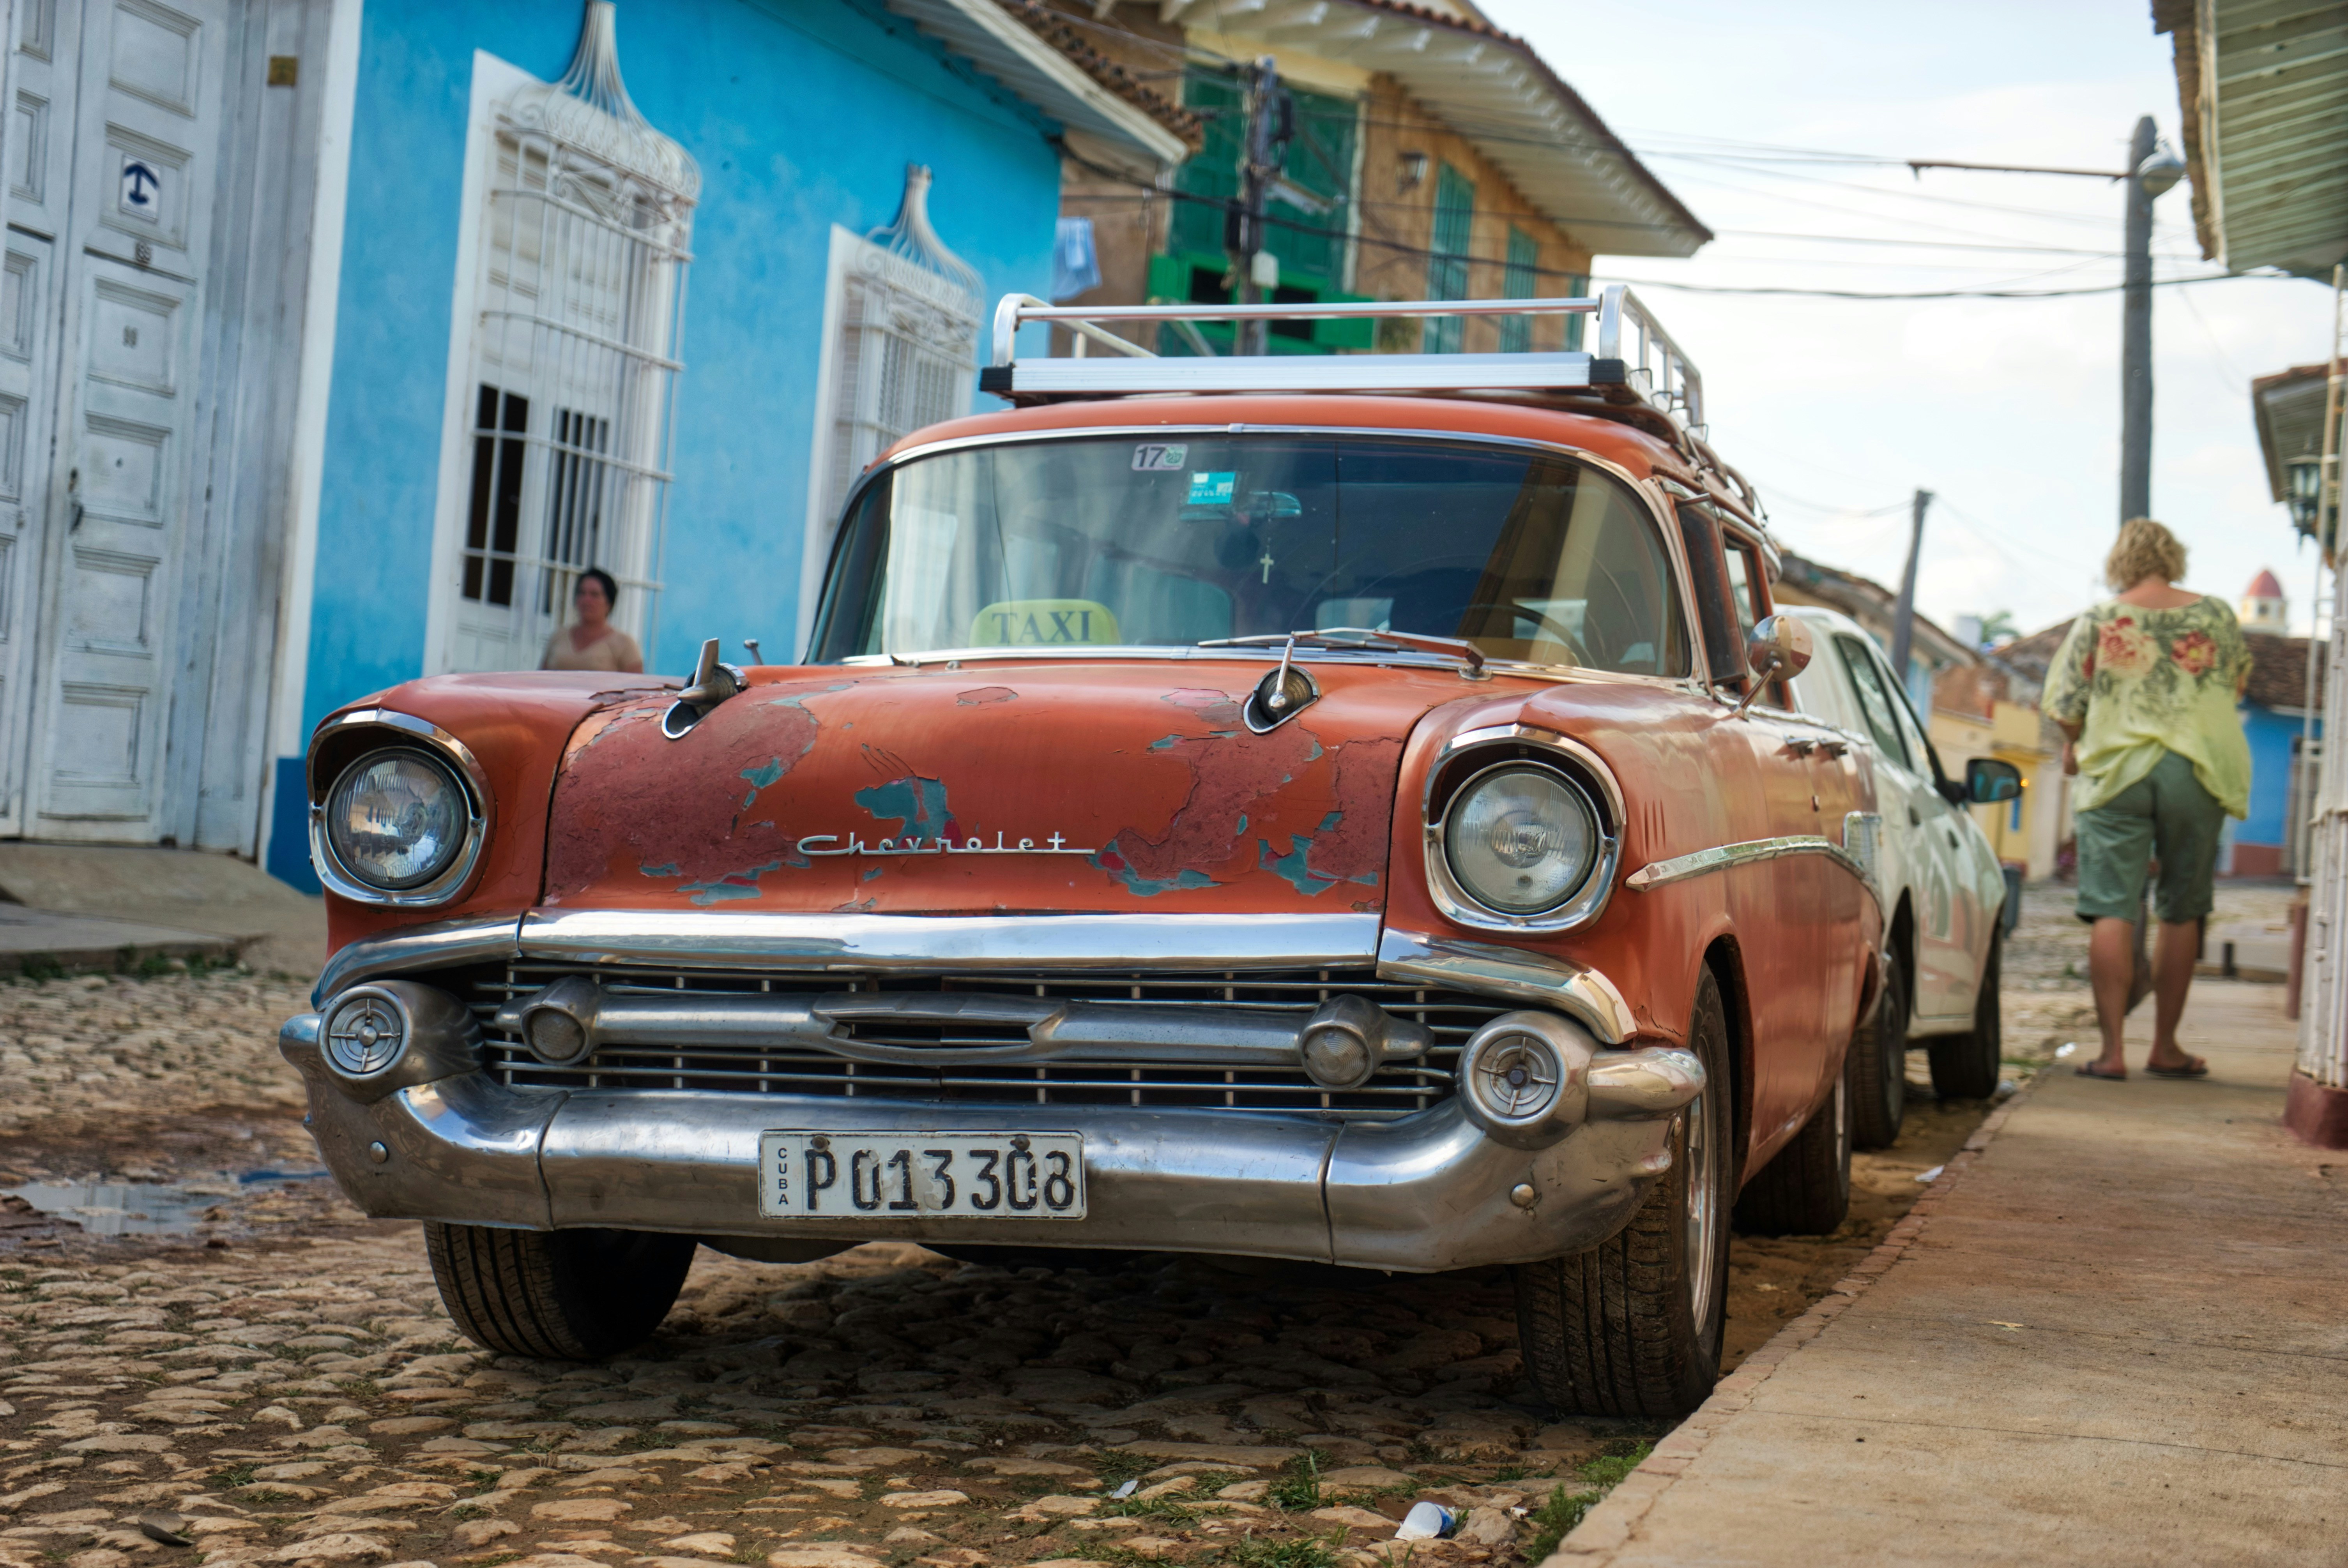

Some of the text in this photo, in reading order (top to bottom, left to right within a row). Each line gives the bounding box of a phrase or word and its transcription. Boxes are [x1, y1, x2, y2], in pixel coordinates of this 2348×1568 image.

[1137, 446, 1166, 467] 17
[992, 611, 1093, 644] TAXI
[797, 831, 1096, 856] Chevrolet
[778, 1147, 789, 1205] CUBA
